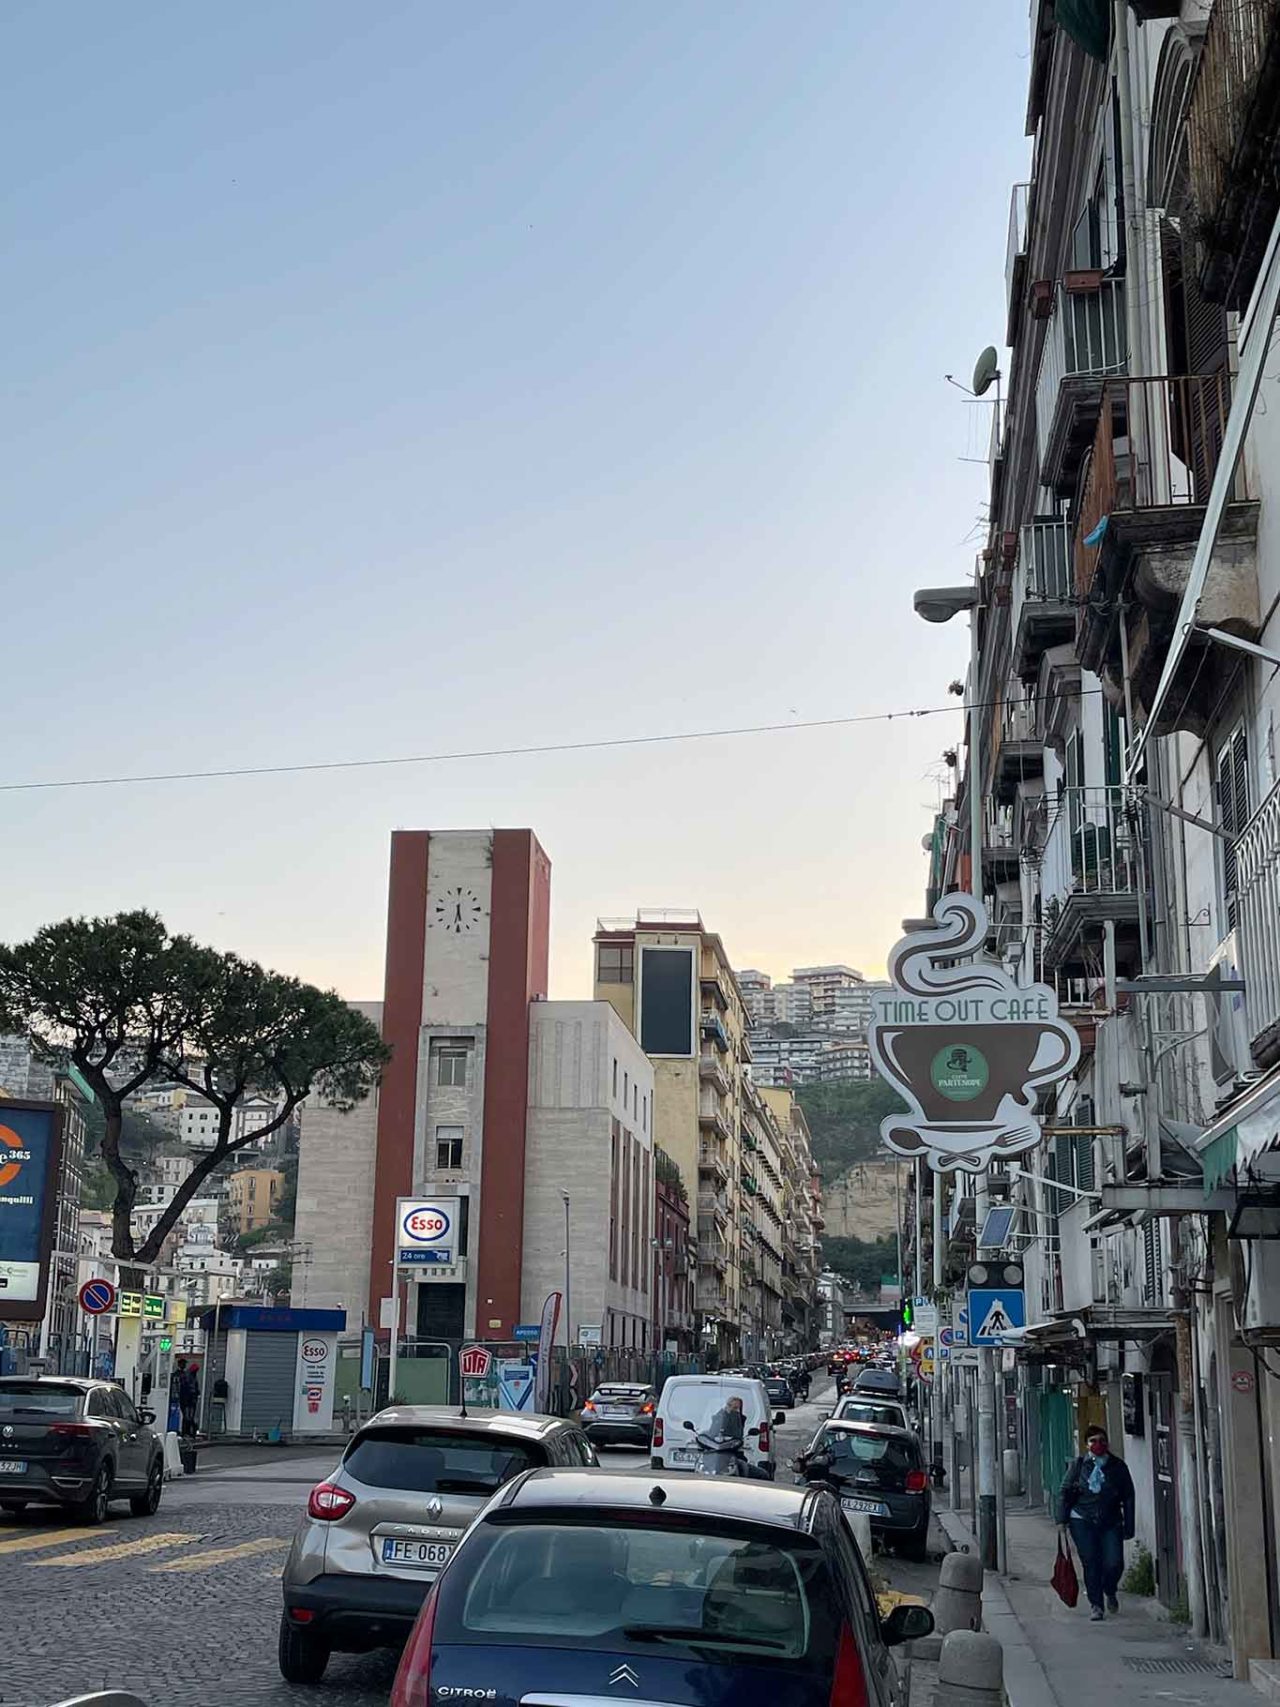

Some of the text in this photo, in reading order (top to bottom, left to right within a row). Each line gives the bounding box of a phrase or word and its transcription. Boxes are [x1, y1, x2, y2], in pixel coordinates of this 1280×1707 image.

[879, 993, 1048, 1023] TIME OUT CAFÈ
[402, 1252, 412, 1260] 24
[463, 1354, 487, 1375] UTA
[394, 1542, 413, 1559] FE
